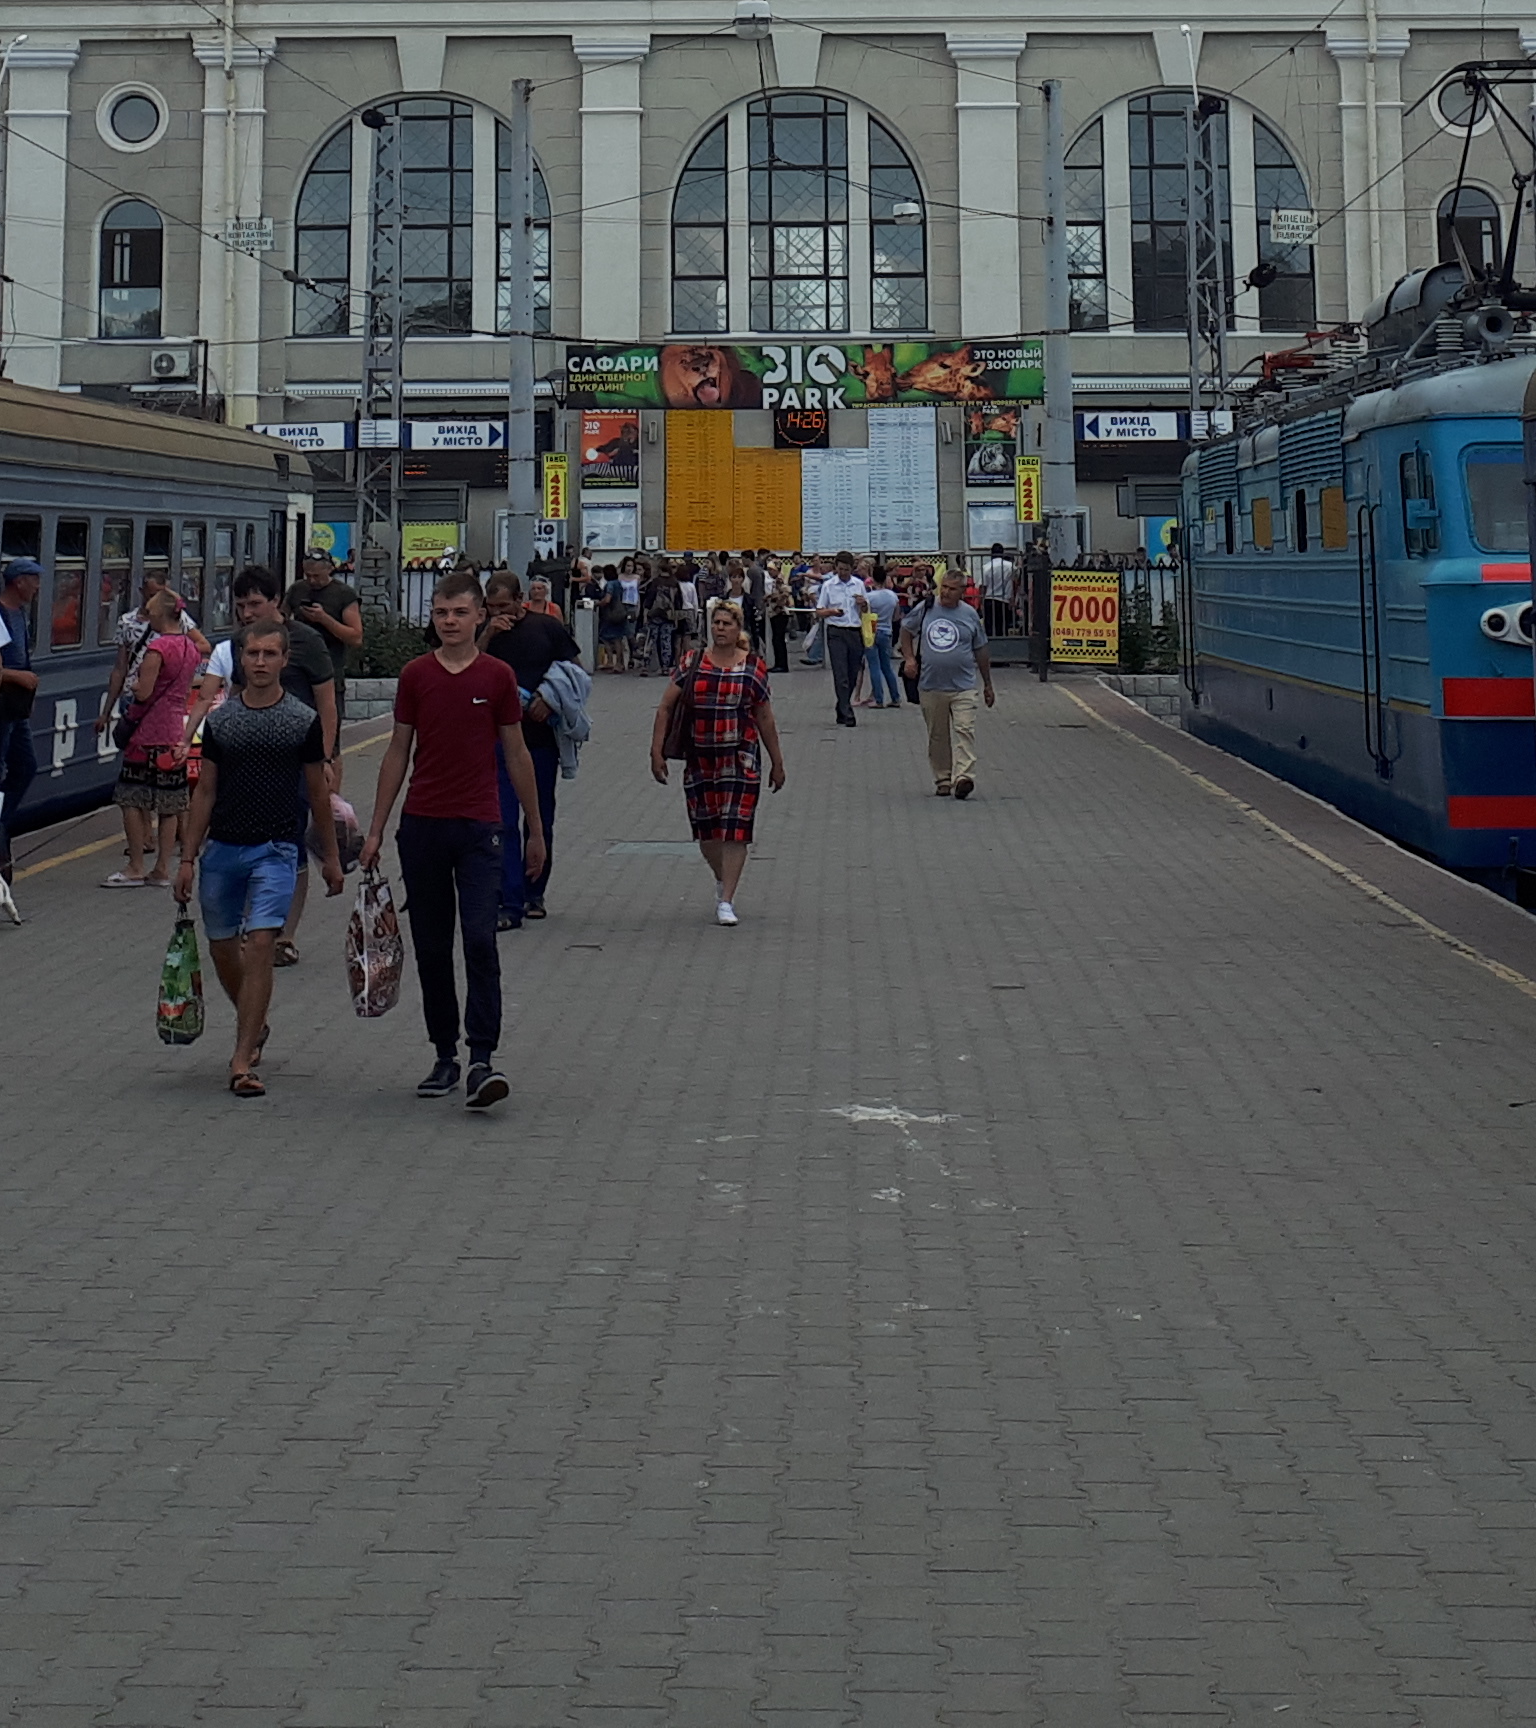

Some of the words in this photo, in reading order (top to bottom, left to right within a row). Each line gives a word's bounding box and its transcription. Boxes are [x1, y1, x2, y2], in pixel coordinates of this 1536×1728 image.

[973, 350, 996, 360] ЭТО
[998, 347, 1042, 360] НОВЫЙ
[567, 355, 659, 373] САФАРИ
[986, 359, 1042, 370] ЗООПАРК
[569, 373, 647, 382] ЕДИНСТВЕННОЕ
[569, 383, 576, 392] В
[578, 383, 625, 392] УКРАИНЕ
[762, 387, 847, 410] PARK
[786, 411, 824, 429] 14:26
[1110, 416, 1151, 427] ВИХІД
[279, 426, 319, 437] ВИХІД
[437, 425, 478, 436] ВИХІД
[1104, 428, 1113, 437] У
[1116, 427, 1157, 437] МІСТО
[431, 437, 440, 447] У
[442, 436, 483, 446] МІСТО
[1053, 594, 1117, 624] 7000
